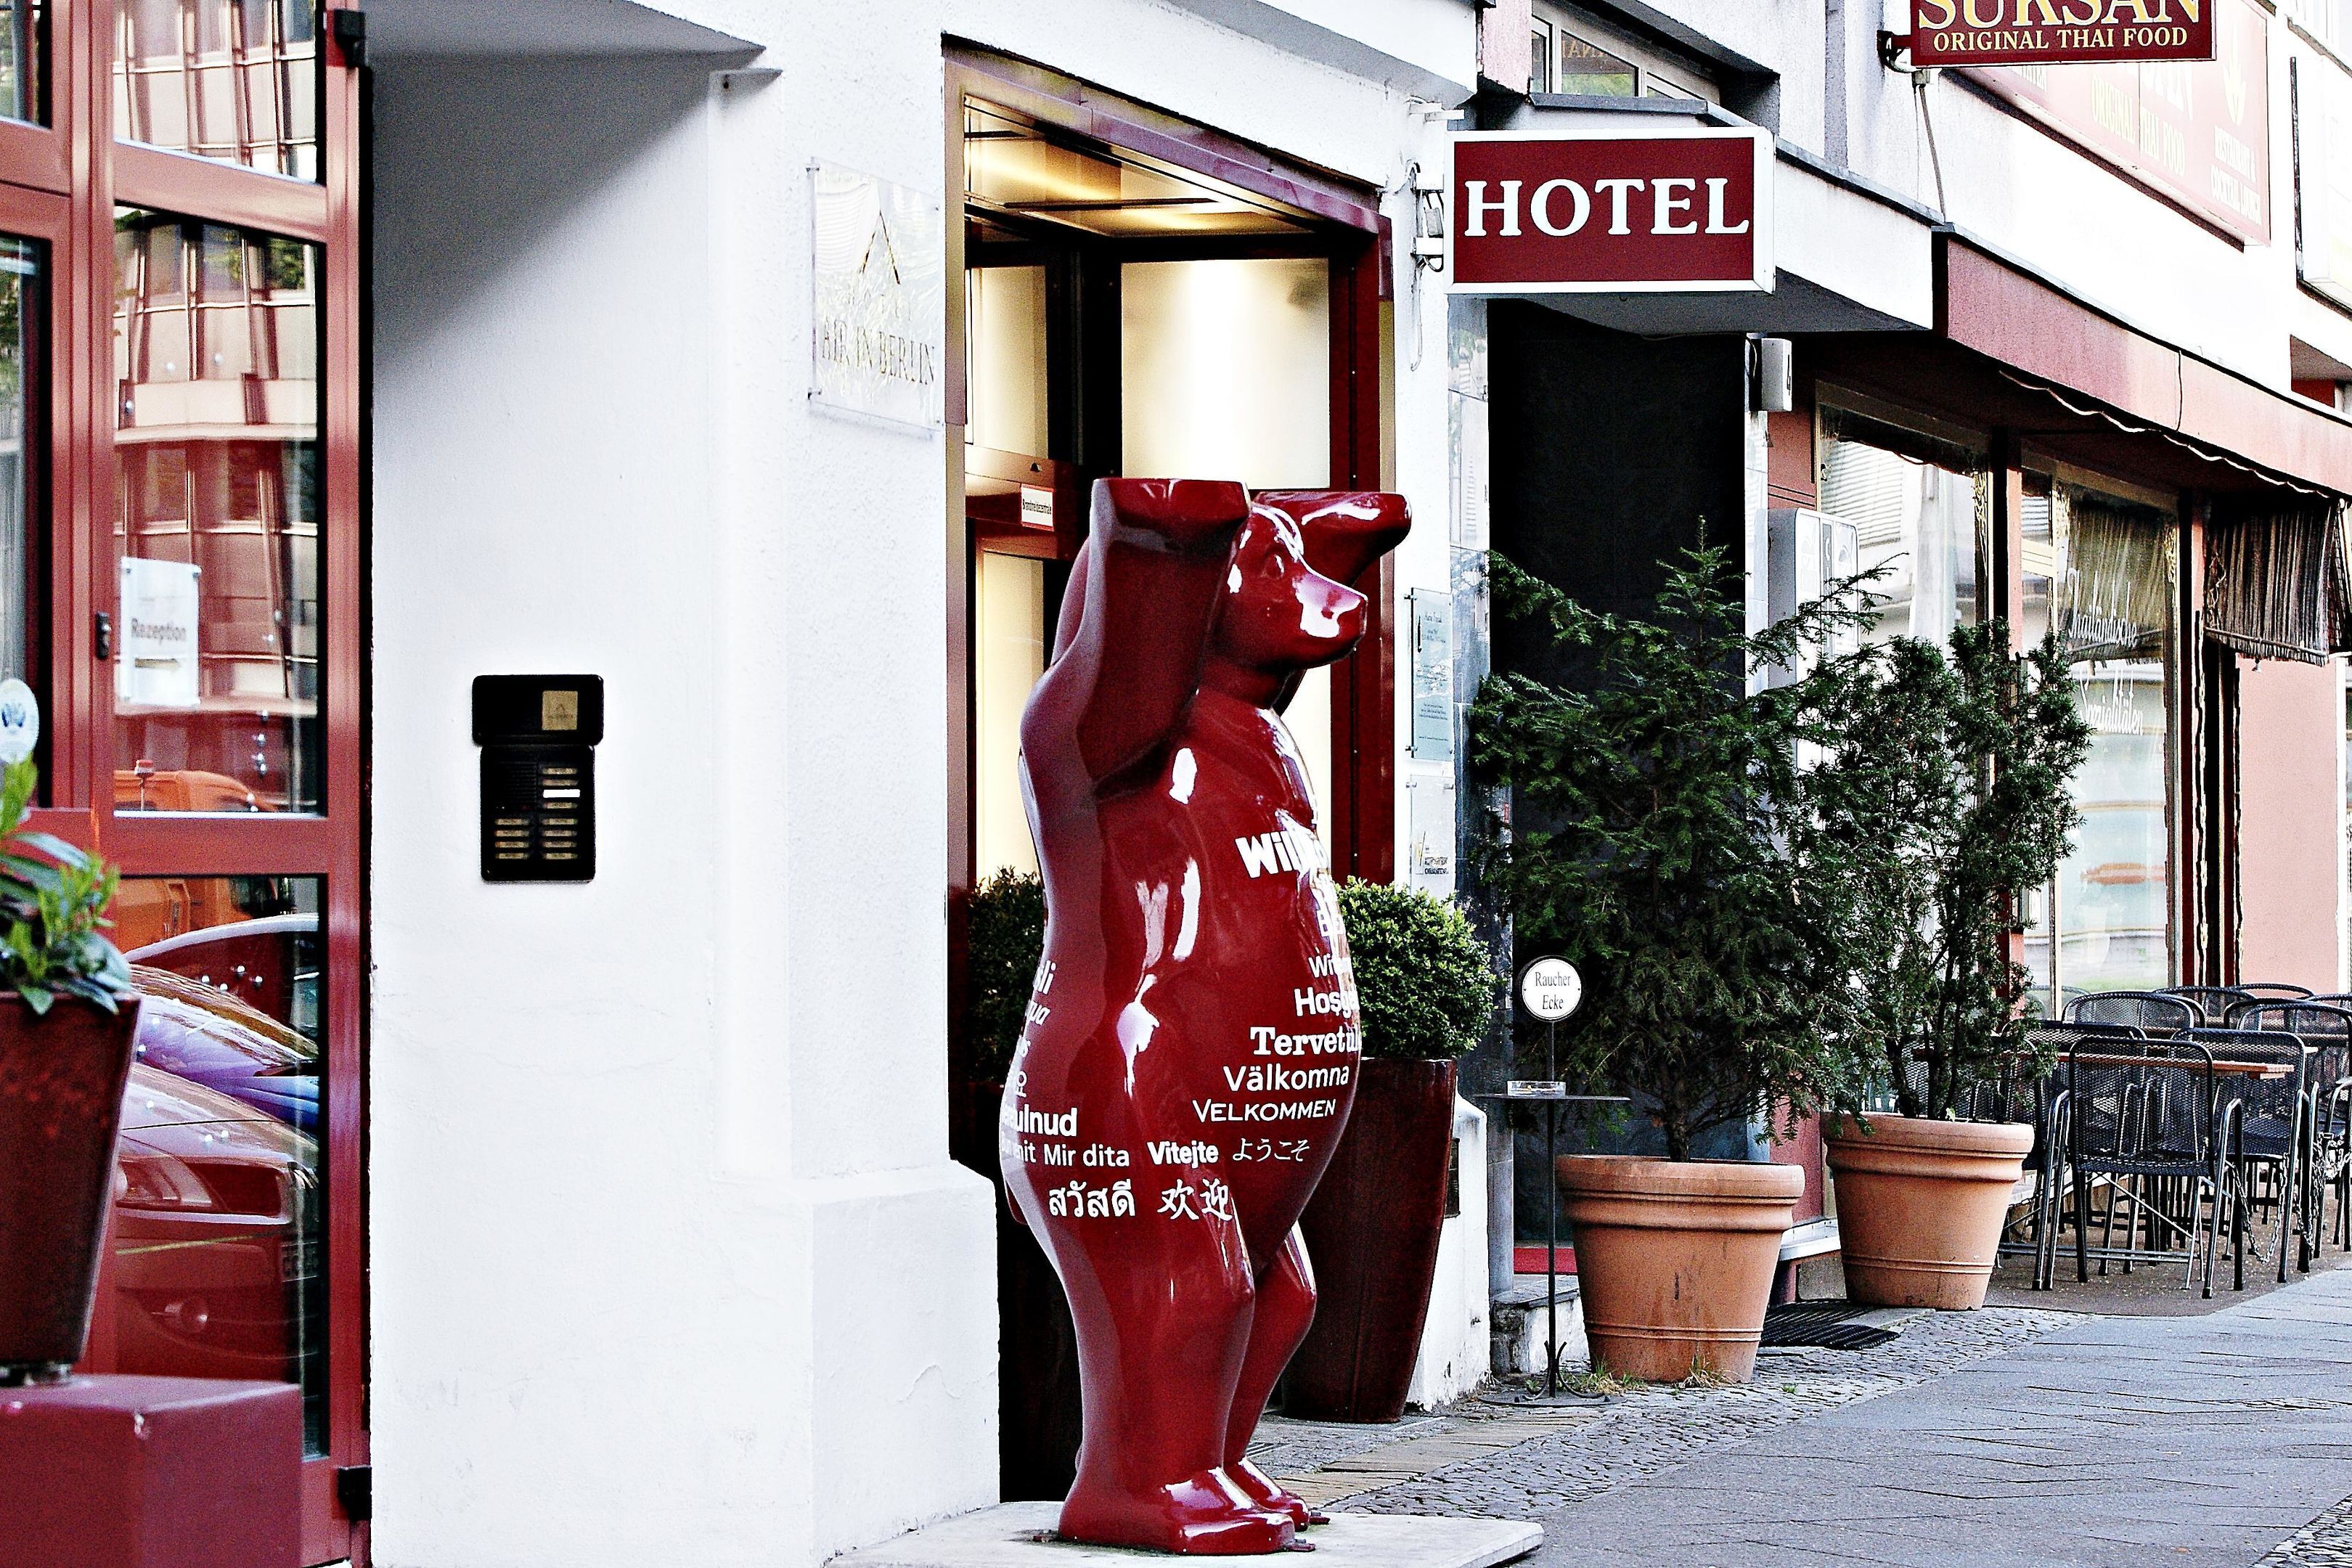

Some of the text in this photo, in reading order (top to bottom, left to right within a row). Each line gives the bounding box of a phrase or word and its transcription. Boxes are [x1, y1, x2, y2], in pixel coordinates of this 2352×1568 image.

[1933, 27, 2187, 52] ORIGINAL THAI FOOD
[2091, 73, 2136, 144] ORIGINAL
[2163, 121, 2185, 176] FOOD
[1463, 177, 1750, 237] HOTEL
[879, 331, 935, 385] BERLIN
[1535, 971, 1571, 987] Raucher
[1542, 995, 1564, 1010] Ecke
[1222, 1063, 1350, 1092] Välkomna
[1192, 1098, 1336, 1123] VELKOMMEN
[1043, 1143, 1077, 1167] Mir
[1082, 1143, 1130, 1167] dita
[1147, 1140, 1220, 1169] Vitejte
[1232, 1138, 1310, 1162] ようこそ
[1048, 1178, 1136, 1218] สวัสดี
[1156, 1178, 1233, 1222] 欢迎
